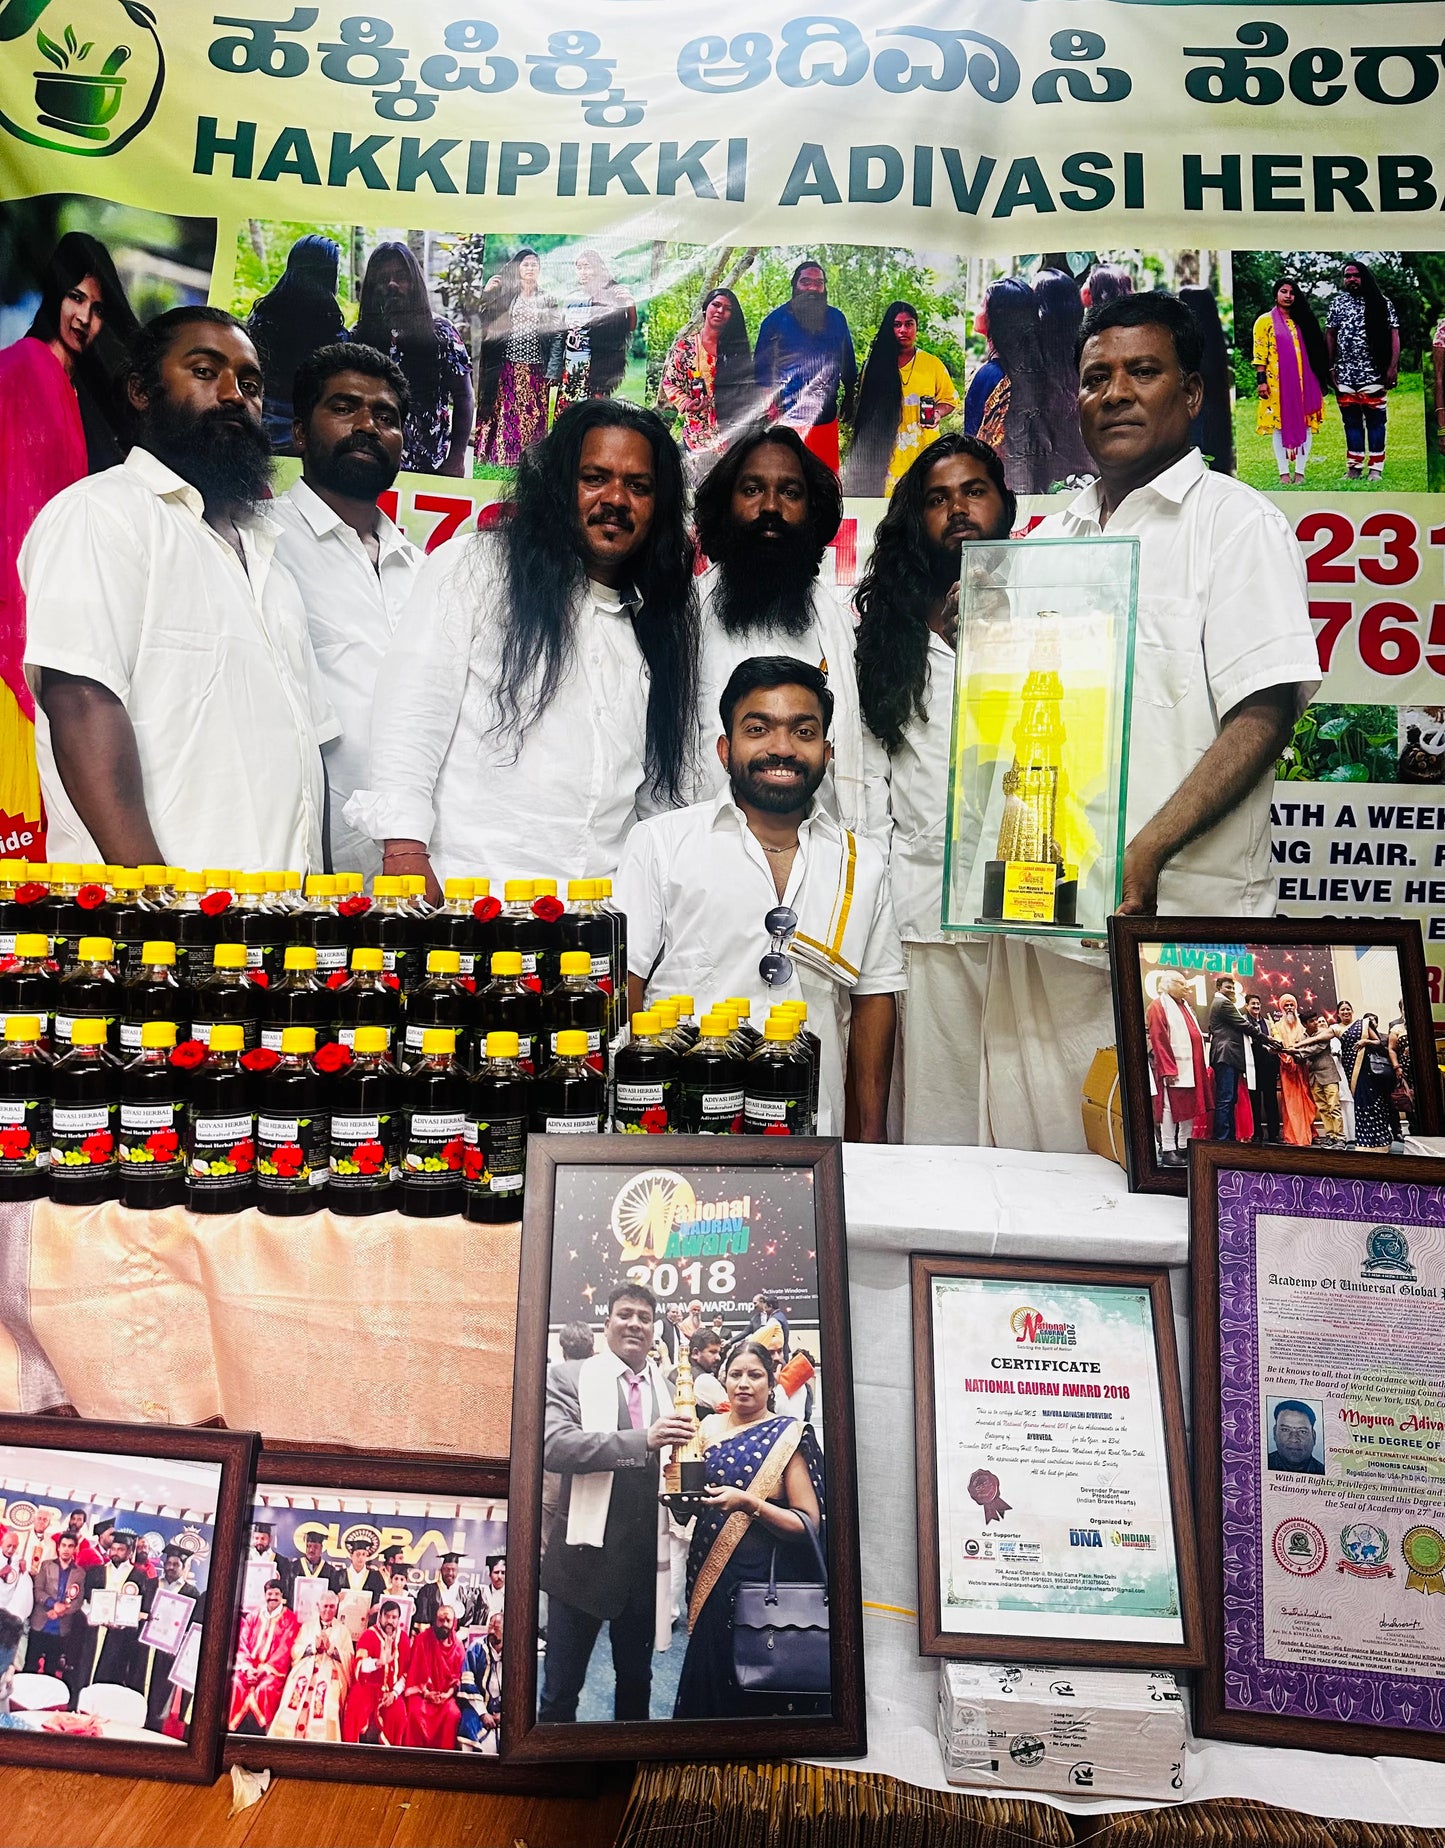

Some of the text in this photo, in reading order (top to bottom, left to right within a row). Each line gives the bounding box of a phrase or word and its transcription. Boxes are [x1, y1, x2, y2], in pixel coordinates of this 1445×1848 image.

[207, 7, 648, 127] ಹಕ್ಕಿಪಿಕ್ಕಿ
[677, 16, 1133, 106] ಆದಿವಾಸಿ
[193, 115, 1445, 219] HAKKIPIKKI ADIVASI HERB
[1335, 805, 1357, 828] A
[1330, 842, 1416, 866] HAIR.
[1157, 943, 1255, 977] Award
[224, 1120, 250, 1128] HERBAL
[663, 1226, 750, 1259] Award
[1268, 1273, 1437, 1298] Academy Of Universal Global
[1035, 1332, 1068, 1345] Award
[990, 1357, 1101, 1374] CERTIFICATE
[1267, 1365, 1277, 1373] Be
[1286, 1367, 1310, 1376] knows
[1335, 1372, 1351, 1380] that
[1362, 1374, 1408, 1385] accordance
[1409, 1378, 1427, 1387] with
[965, 1378, 1131, 1400] NATIONAL GAURAV AWARD 2018
[1276, 1376, 1298, 1386] them,
[1300, 1378, 1314, 1386] The
[1315, 1379, 1339, 1388] Board
[1340, 1381, 1350, 1390] of
[1350, 1383, 1374, 1392] World
[1375, 1384, 1416, 1398] Governing
[1326, 1391, 1363, 1402] Academy,
[1364, 1394, 1382, 1402] New
[1424, 1399, 1435, 1407] Do
[1338, 1408, 1395, 1429] Mayura
[1352, 1434, 1441, 1450] THE DEGREE OF
[1329, 1447, 1354, 1455] DOCTOR
[1364, 1450, 1409, 1460] ALETERNATIVE
[1410, 1454, 1437, 1462] HEALING
[1346, 1469, 1377, 1478] Registration
[1368, 1461, 1428, 1473] [HONORIS CAUSA]
[1269, 1483, 1442, 1508] Testimony where of then caused this Degree
[1275, 1473, 1294, 1483] With
[1295, 1475, 1307, 1484] all
[1307, 1476, 1336, 1488] Rights,
[1336, 1479, 1378, 1492] Privileges,
[1426, 1488, 1443, 1497] and
[1325, 1500, 1339, 1508] the
[1340, 1501, 1357, 1510] Seal
[1357, 1503, 1367, 1512] of
[1367, 1504, 1404, 1516] Academy
[1089, 1518, 1122, 1526] Organized
[1069, 1531, 1103, 1548] DNA
[1121, 1533, 1151, 1543] INDIAN
[1277, 1533, 1284, 1542] OF
[1311, 1530, 1323, 1553] GLOBAL
